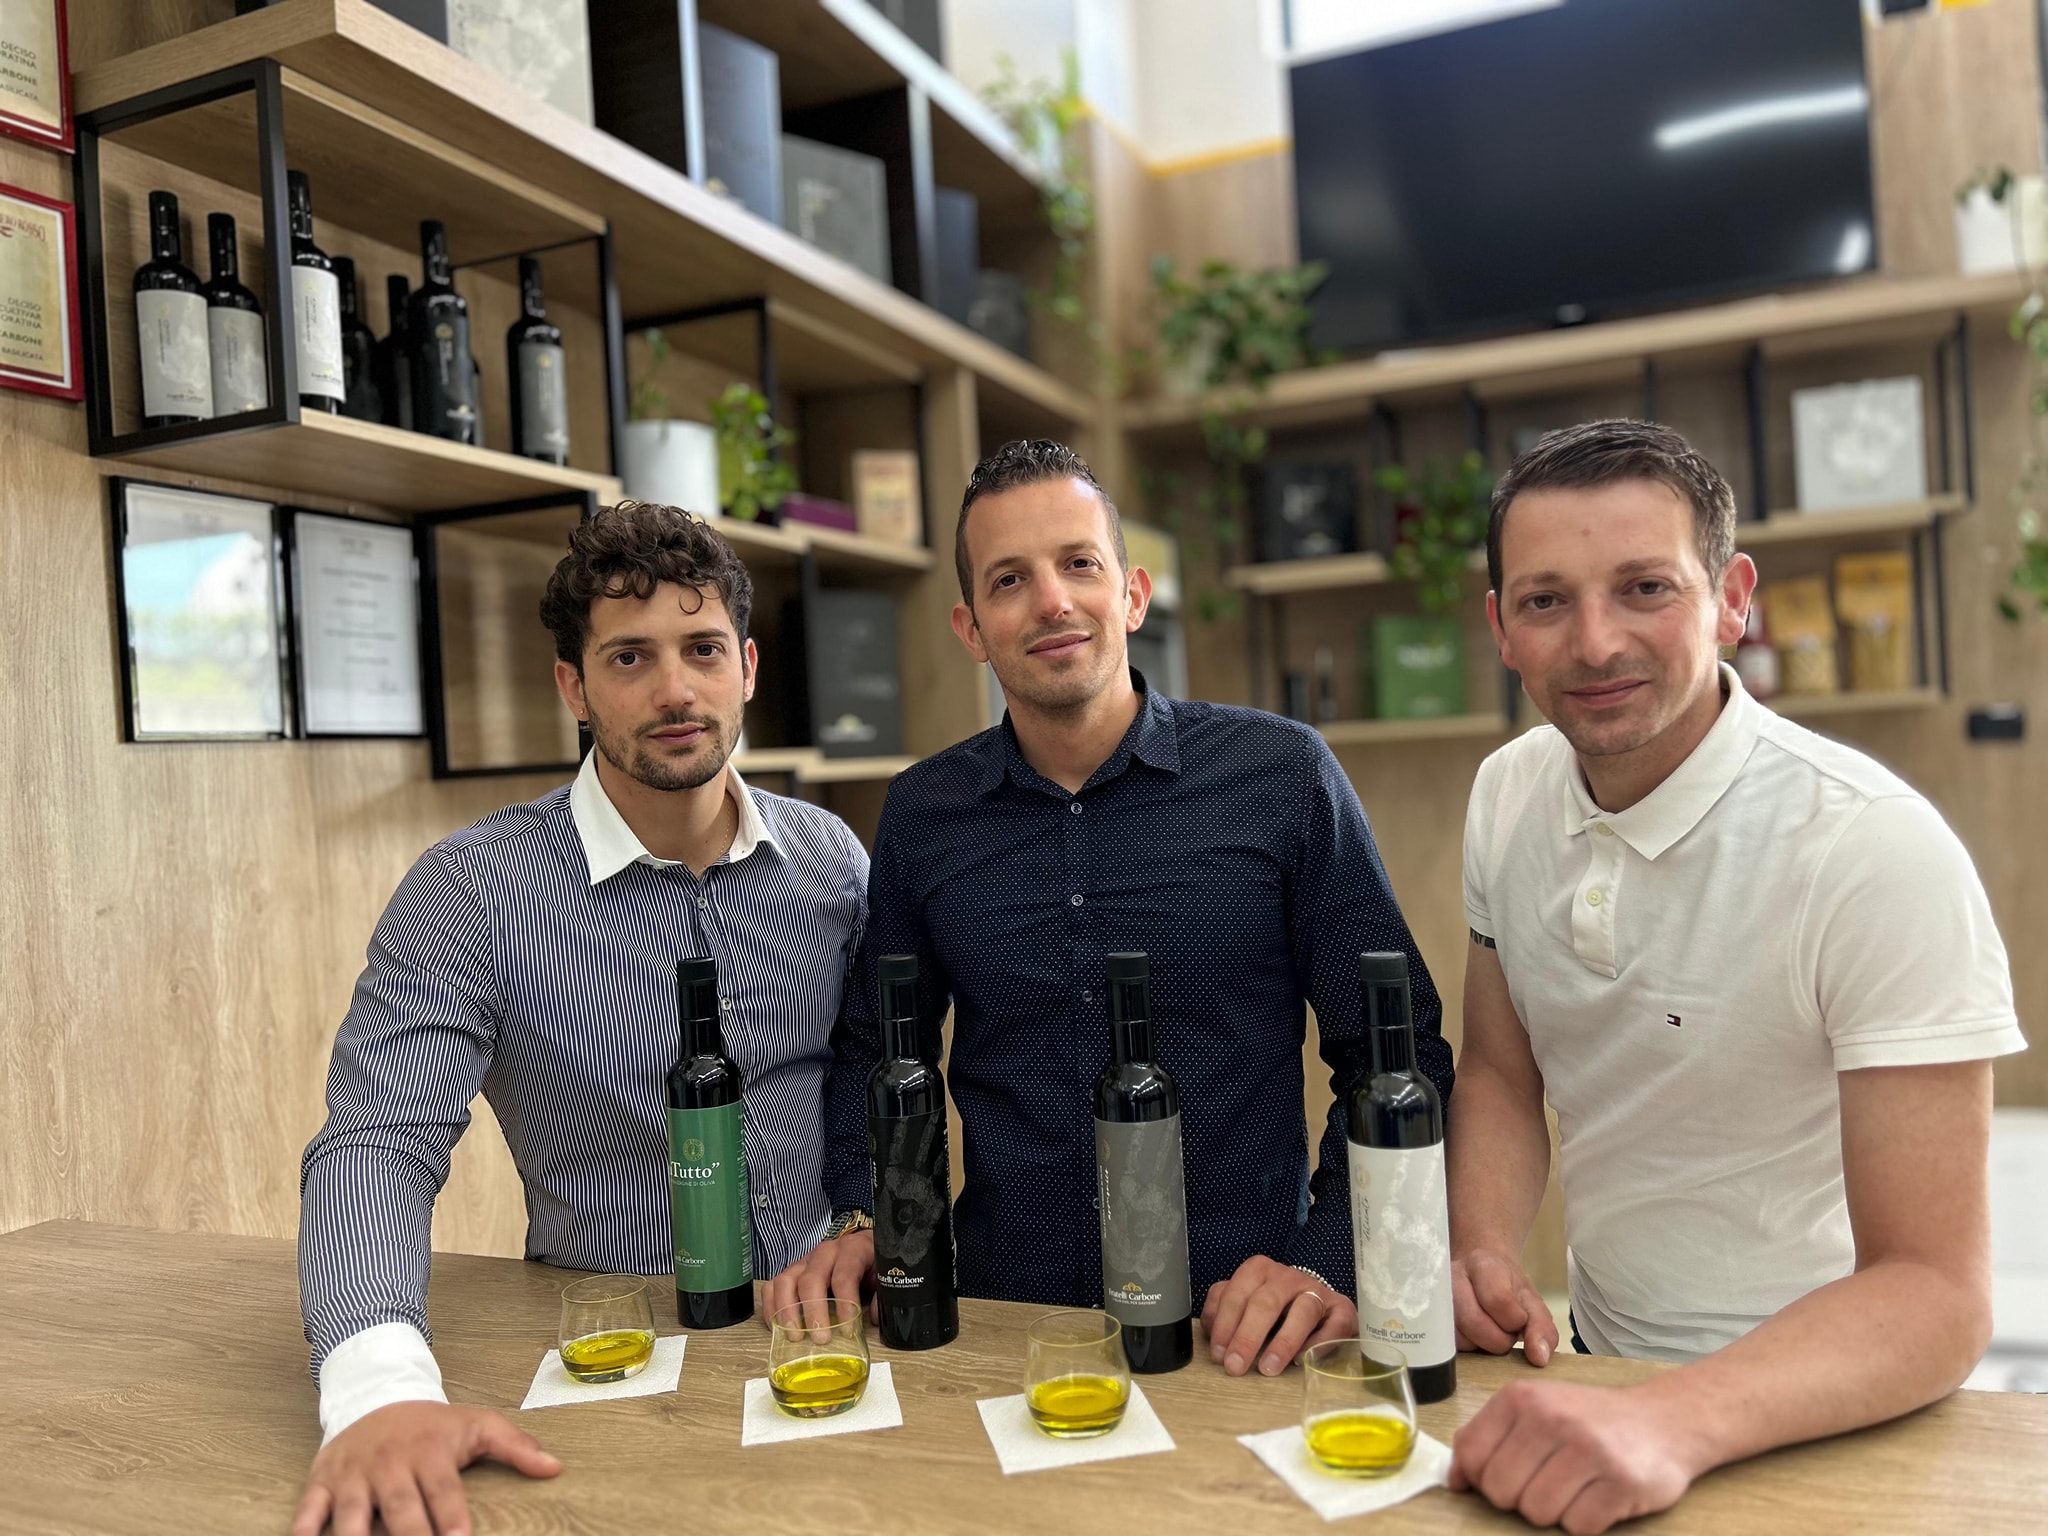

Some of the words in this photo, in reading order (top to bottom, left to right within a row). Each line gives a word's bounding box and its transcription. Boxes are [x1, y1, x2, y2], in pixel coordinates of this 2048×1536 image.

[1, 40, 37, 60] DECISO
[0, 50, 37, 70] RATINA
[0, 67, 38, 86] RBONE
[8, 296, 42, 312] DECISO
[0, 314, 42, 329] ORATINA
[0, 331, 43, 347] ARBONE
[681, 1256, 706, 1265] Carbone
[893, 1276, 925, 1285] Carbone
[1128, 1292, 1162, 1302] Carbone
[1366, 1323, 1388, 1337] Fratelli
[1389, 1330, 1426, 1341] Carbone
